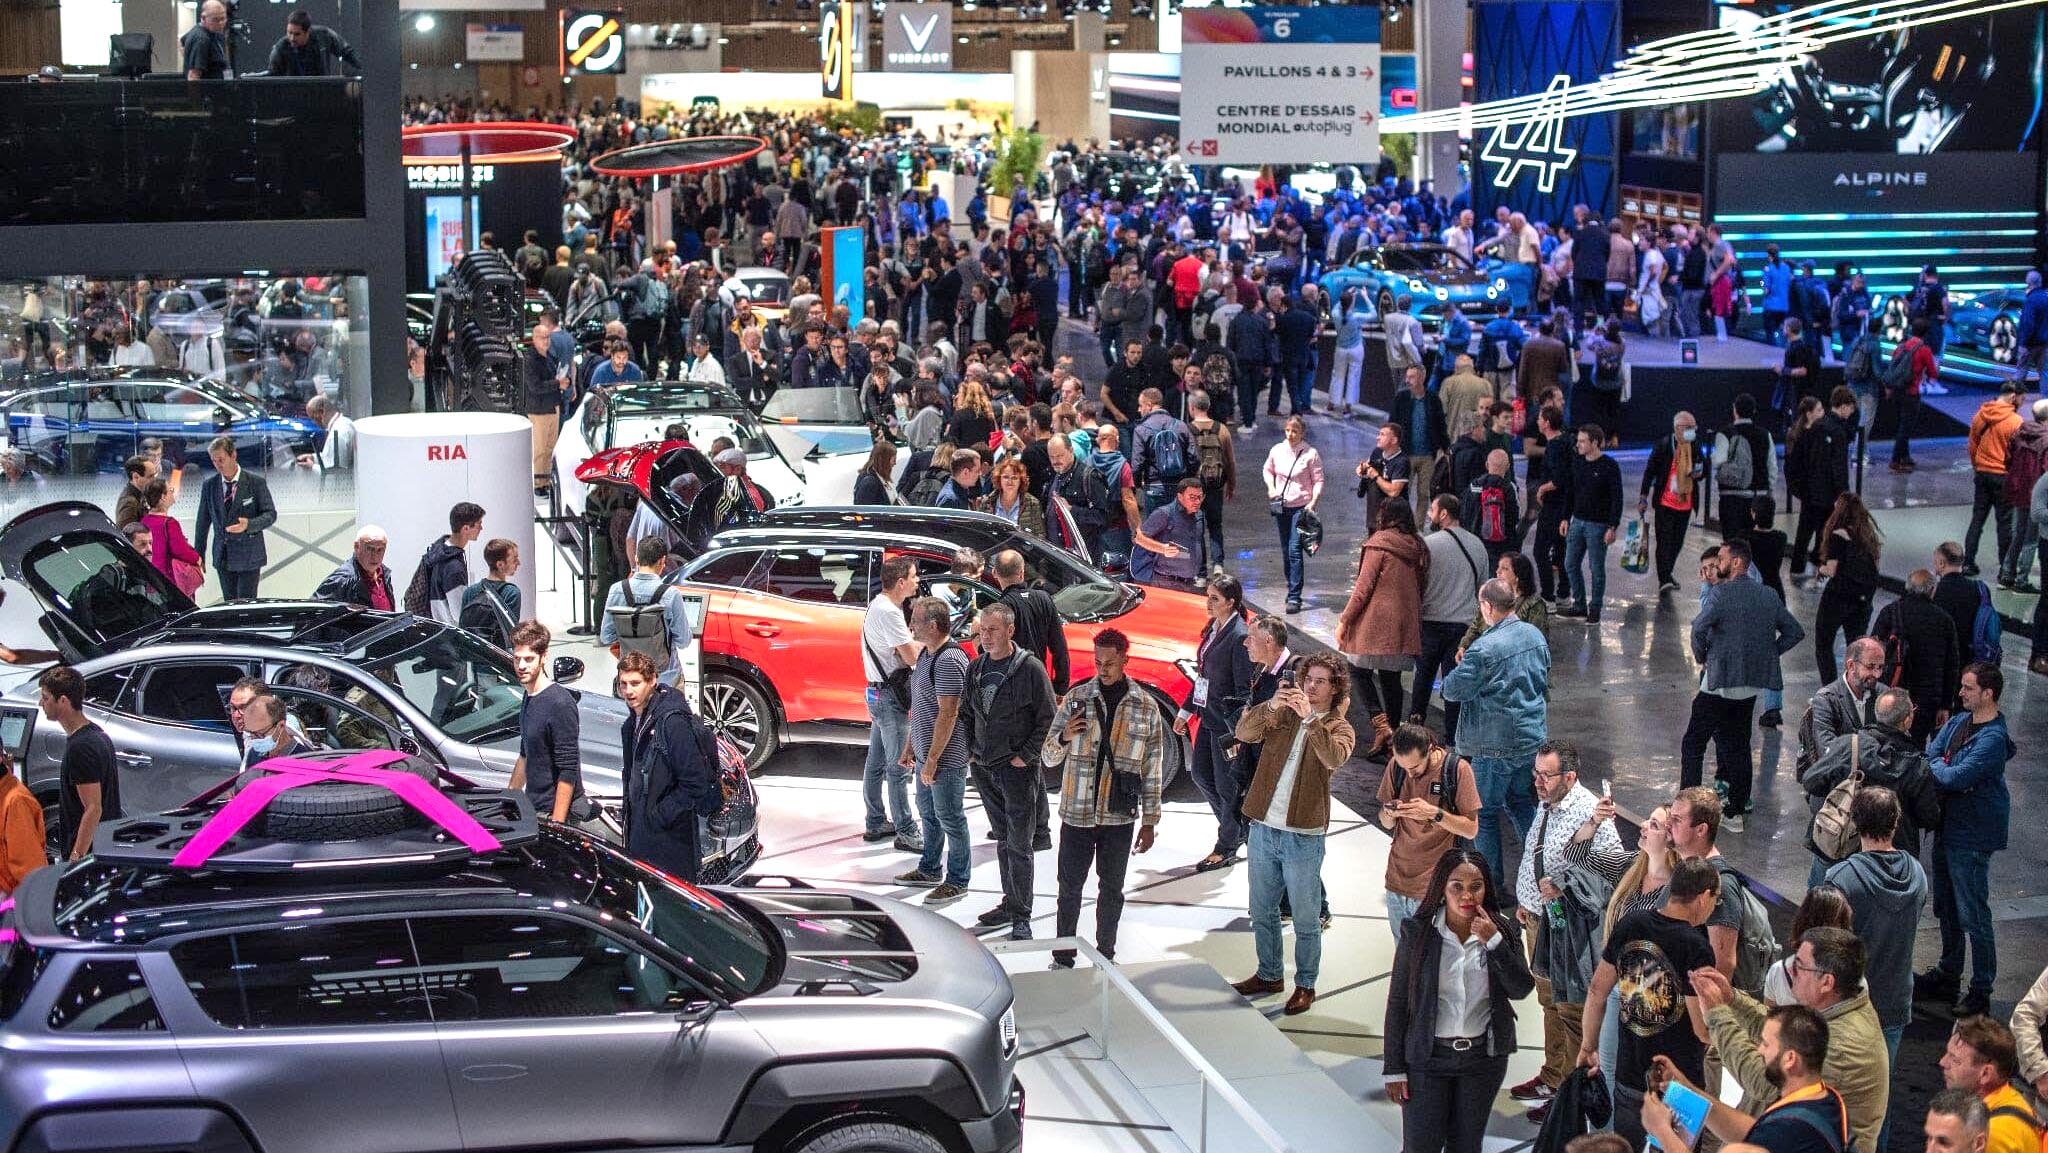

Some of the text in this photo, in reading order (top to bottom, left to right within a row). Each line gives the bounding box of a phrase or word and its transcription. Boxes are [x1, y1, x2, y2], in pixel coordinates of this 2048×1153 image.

[1273, 18, 1291, 38] 6
[1224, 66, 1357, 77] PAVILLONS 4 & 3
[1217, 105, 1356, 117] CENTRE D'ESSAIS
[1218, 122, 1290, 134] MONDIAL
[1833, 172, 1928, 186] ALPINE
[428, 444, 467, 461] RIA
